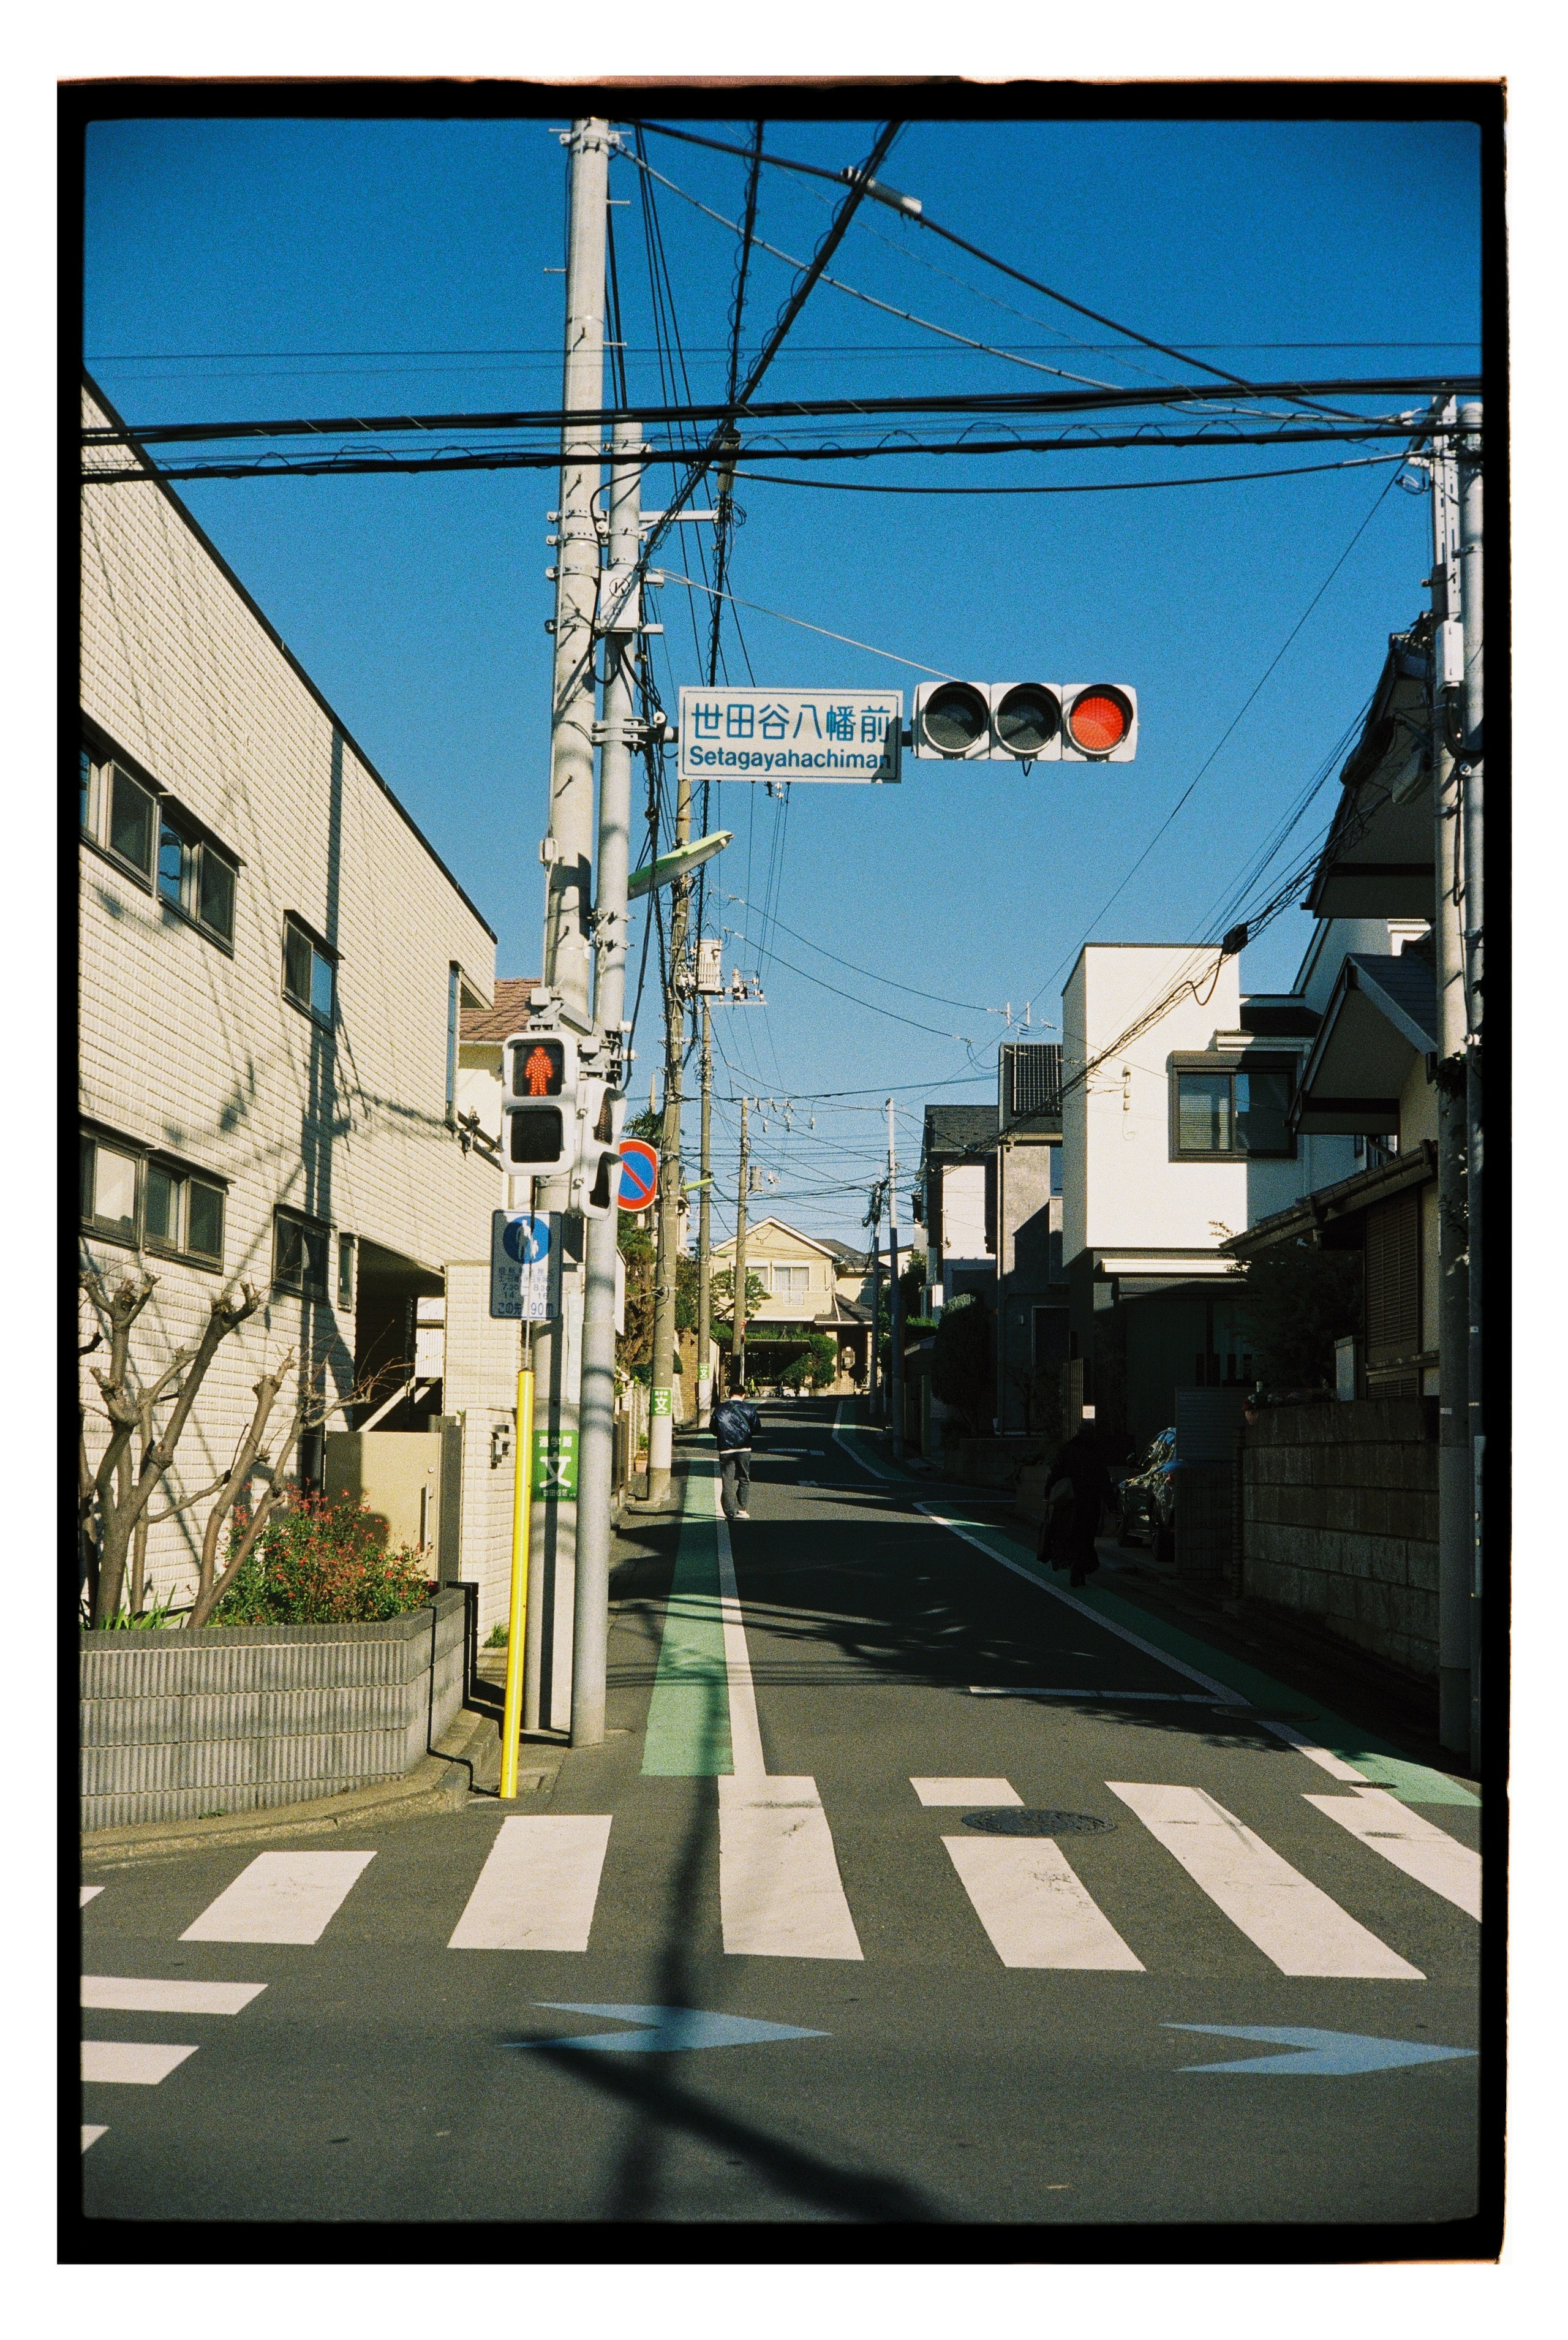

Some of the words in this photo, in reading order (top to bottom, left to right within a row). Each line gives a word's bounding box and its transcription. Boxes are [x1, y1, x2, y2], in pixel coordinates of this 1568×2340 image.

[691, 702, 892, 744] 世田谷八幡前
[690, 746, 891, 771] Setagayahachiman
[538, 1451, 573, 1488] 文
